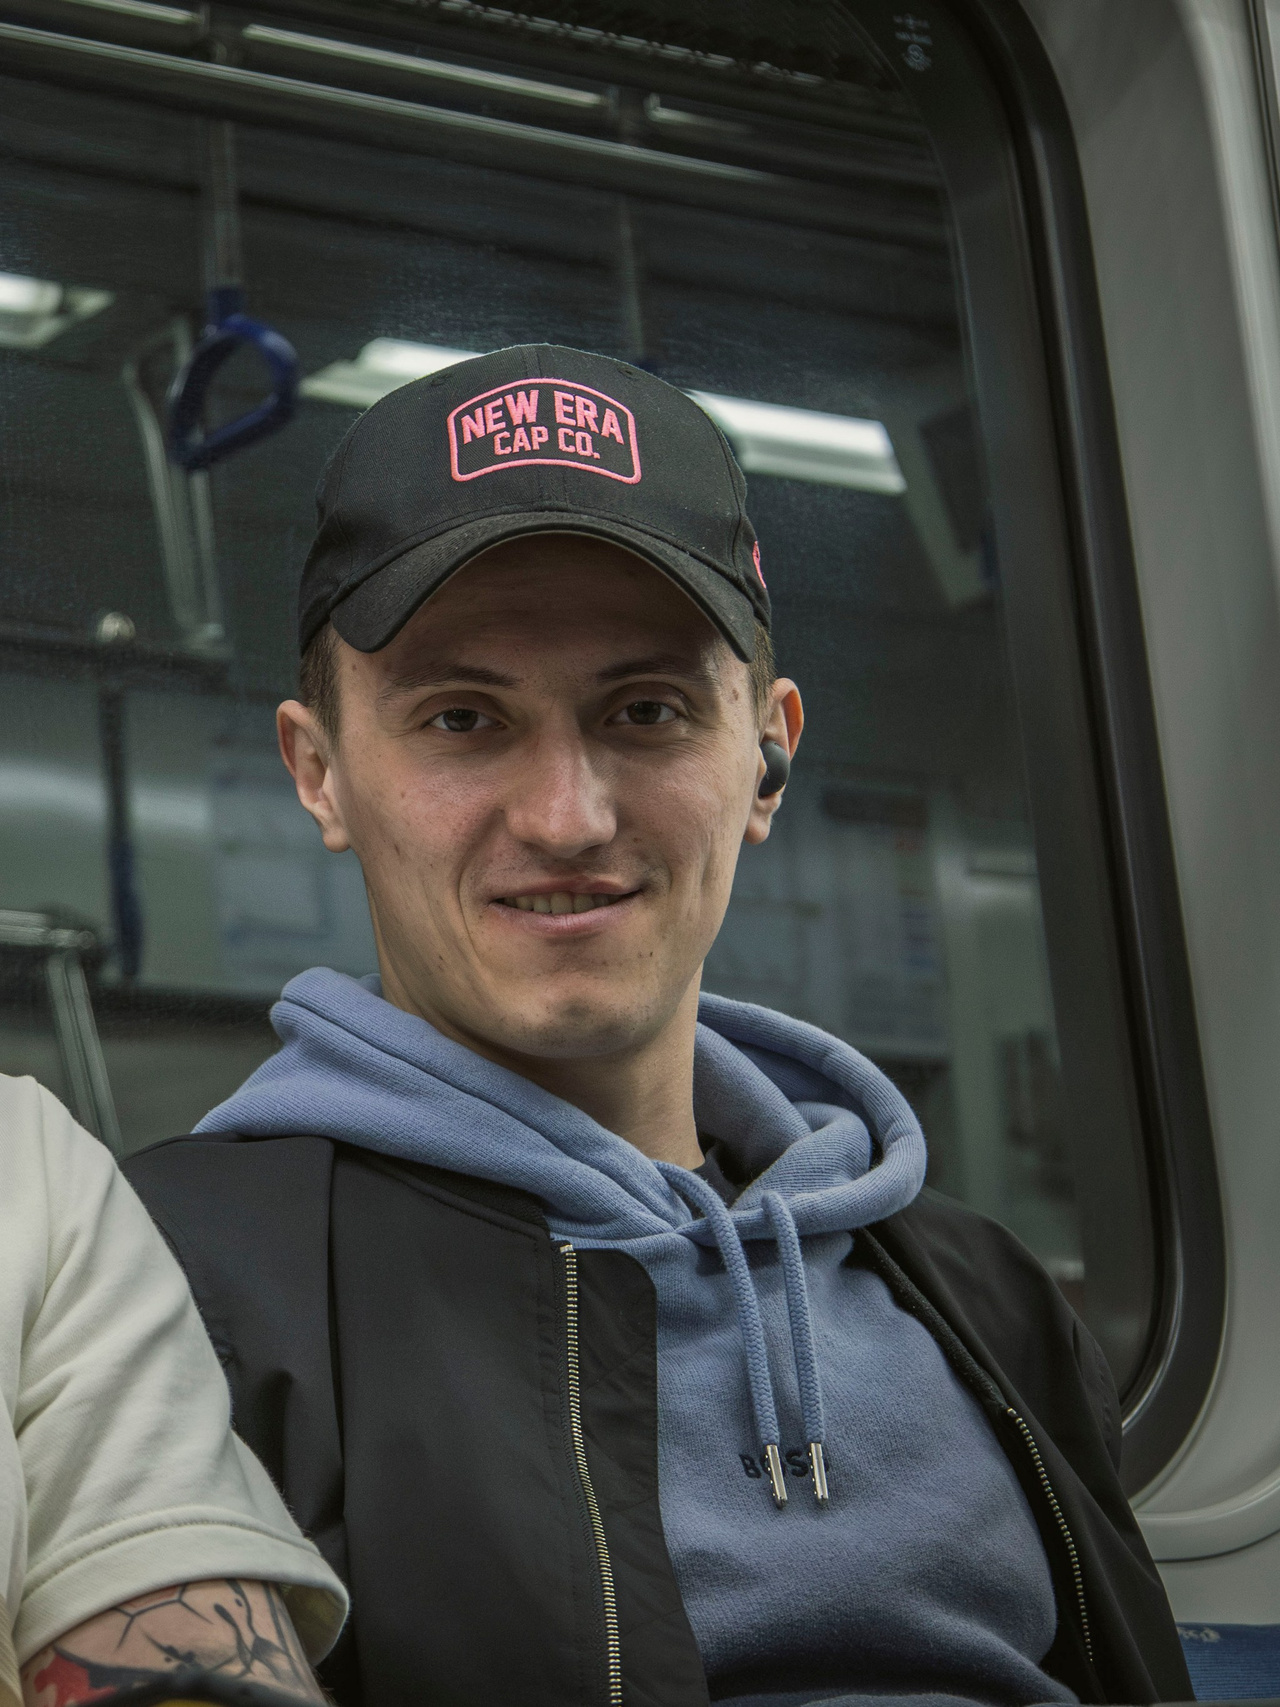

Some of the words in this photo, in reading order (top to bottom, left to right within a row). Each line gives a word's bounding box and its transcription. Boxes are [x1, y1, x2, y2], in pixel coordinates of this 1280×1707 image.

[461, 389, 539, 445] NEW
[554, 390, 625, 445] ERA
[494, 426, 549, 456] CAP
[557, 427, 601, 459] CO.
